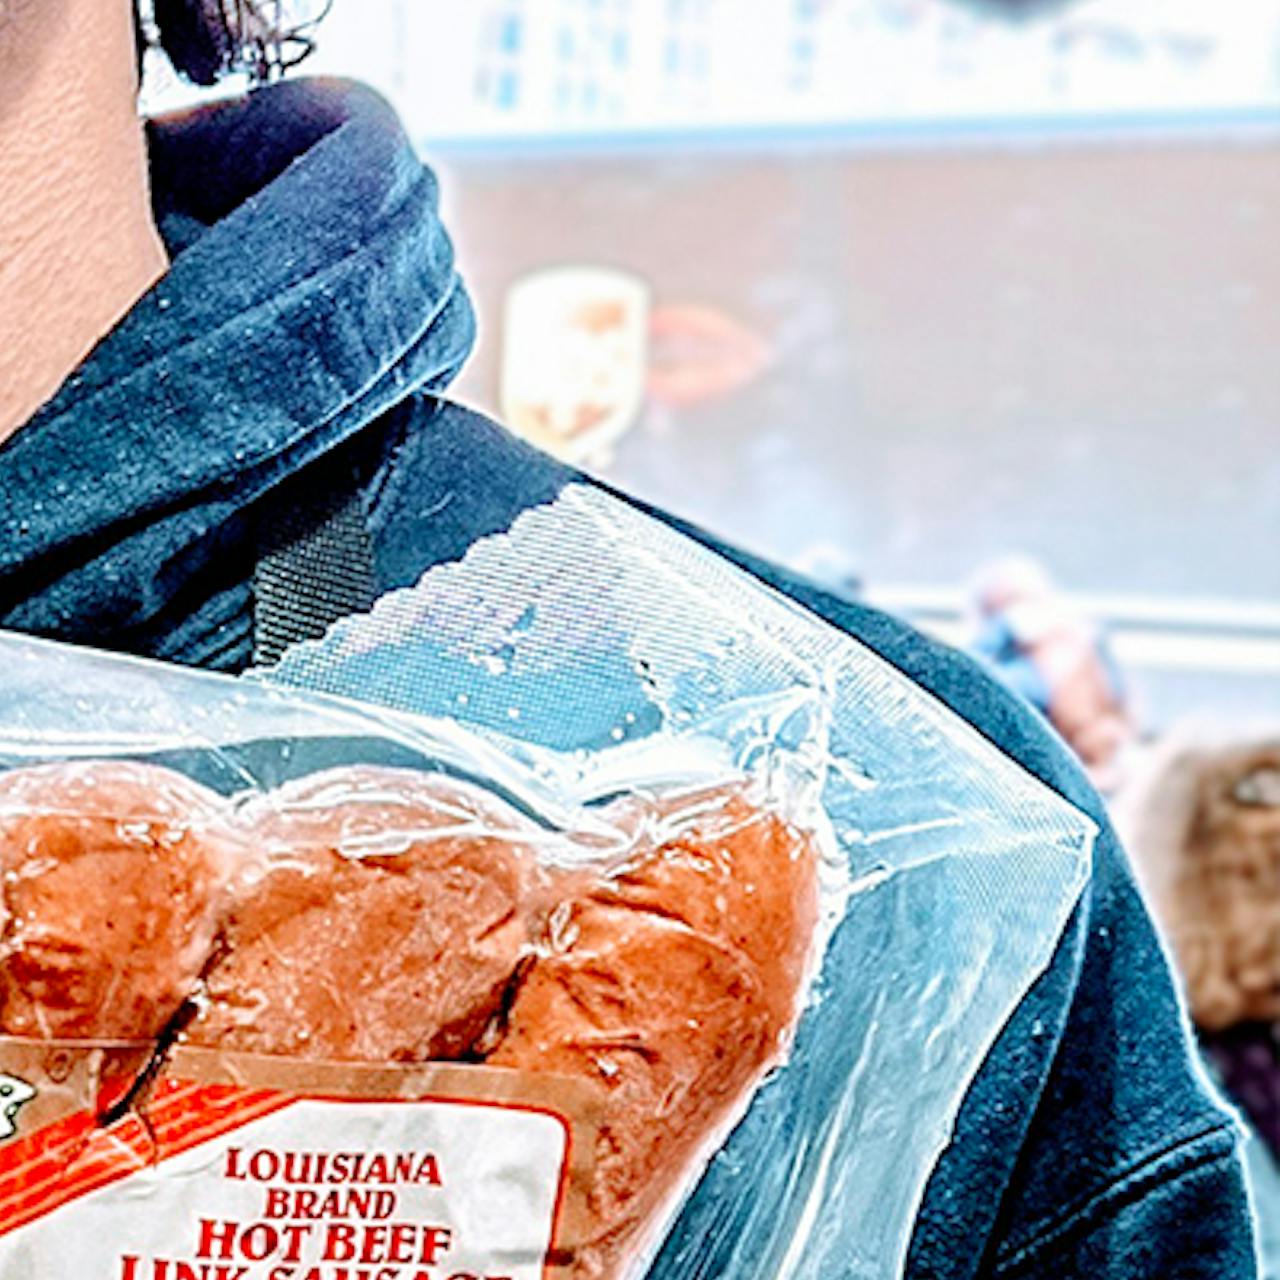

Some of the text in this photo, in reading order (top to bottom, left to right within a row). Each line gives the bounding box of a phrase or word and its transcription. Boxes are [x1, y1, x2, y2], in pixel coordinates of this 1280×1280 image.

[224, 1148, 442, 1187] LOUISIANA
[265, 1188, 397, 1220] BRAND
[196, 1218, 453, 1266] HOT BEEF
